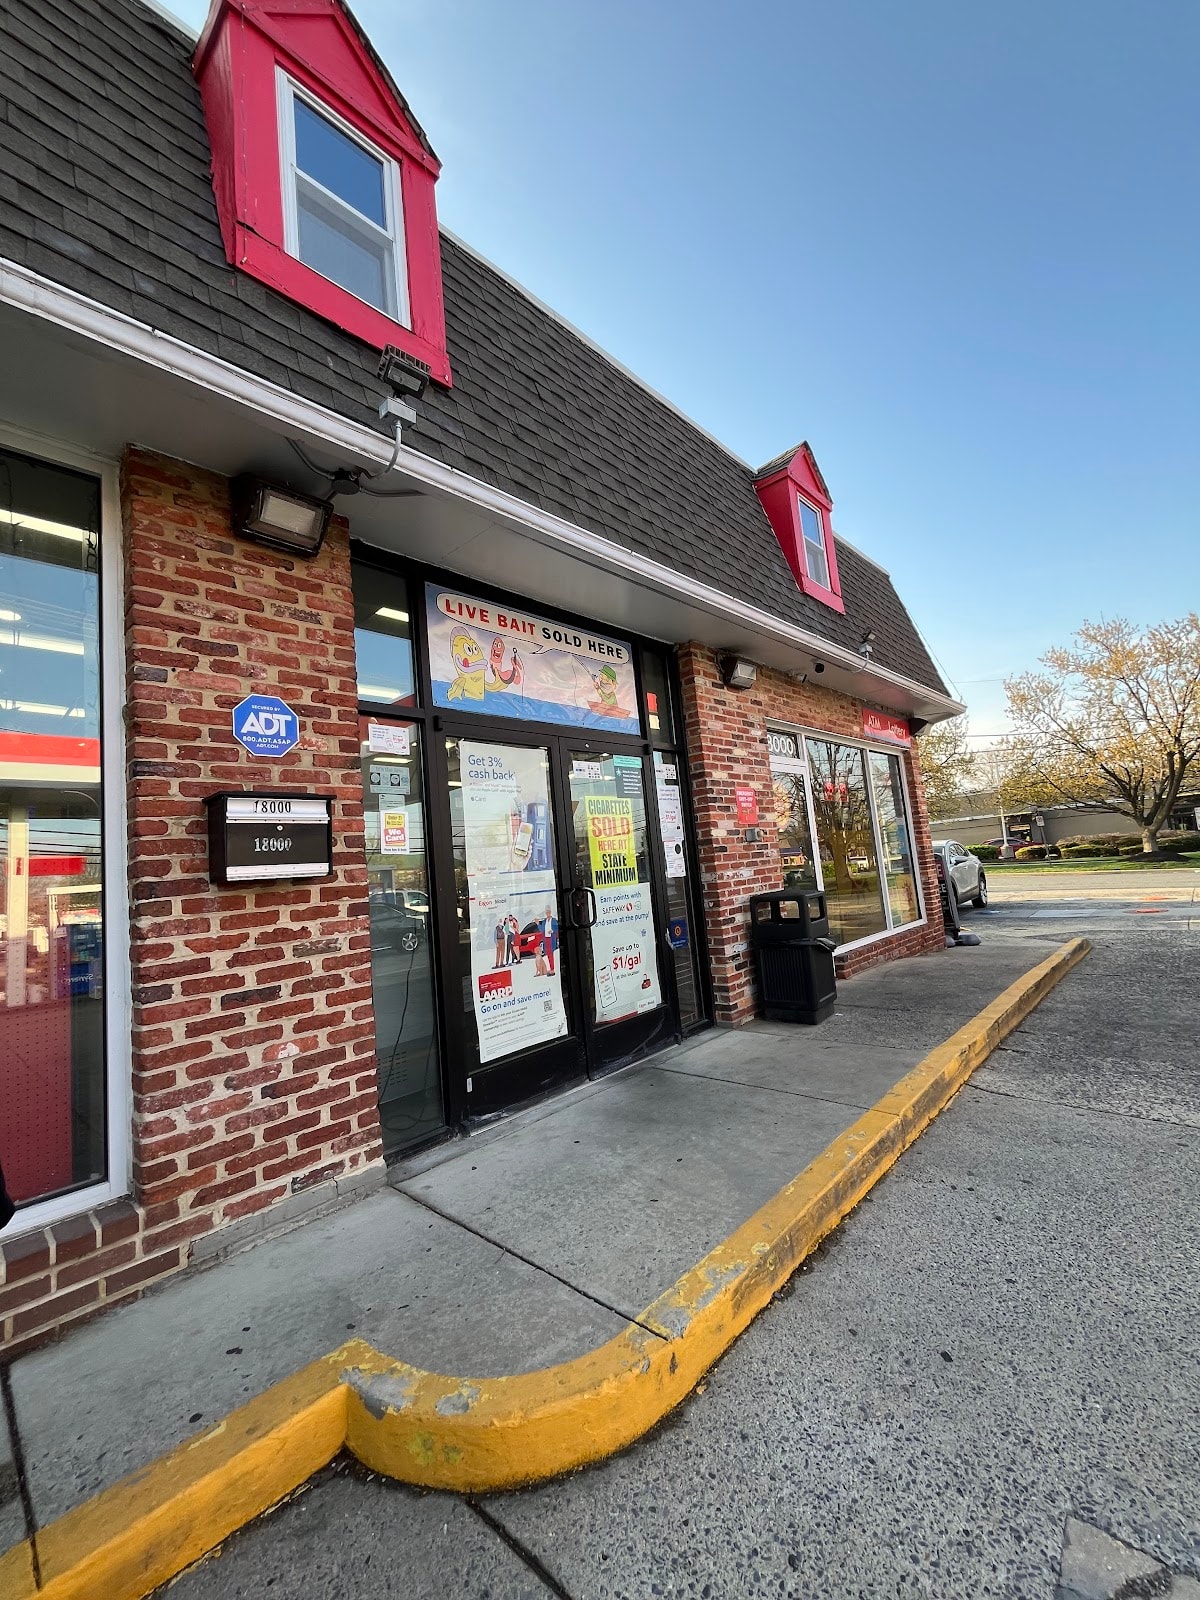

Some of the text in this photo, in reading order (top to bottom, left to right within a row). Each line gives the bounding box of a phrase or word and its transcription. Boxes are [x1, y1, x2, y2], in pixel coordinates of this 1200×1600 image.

[445, 598, 623, 660] LIVE BAIT SOLD HERE
[240, 711, 292, 737] ADT
[868, 714, 881, 730] ATM
[887, 720, 906, 739] Lottery
[242, 735, 291, 745] 800.ADT.ASAP
[468, 754, 503, 768] Get 3%
[468, 769, 490, 779] cash
[254, 800, 292, 814] 18000
[588, 799, 630, 816] CIGARETTES
[388, 828, 402, 836] We
[591, 816, 631, 838] SOLD
[254, 837, 293, 852] 18000
[385, 833, 405, 842] Card
[598, 839, 628, 852] HERE AT
[602, 853, 628, 869] STATE
[595, 867, 637, 886] MINIMUM
[600, 891, 642, 903] Earn points with
[602, 904, 626, 914] SAFEWAY
[595, 919, 606, 927] and
[606, 918, 618, 926] save
[625, 914, 634, 922] the
[612, 946, 625, 954] Save
[626, 944, 633, 952] up
[612, 951, 642, 971] $1/gal
[483, 985, 513, 1001] AARP
[480, 988, 552, 1014] Go on and save more!
